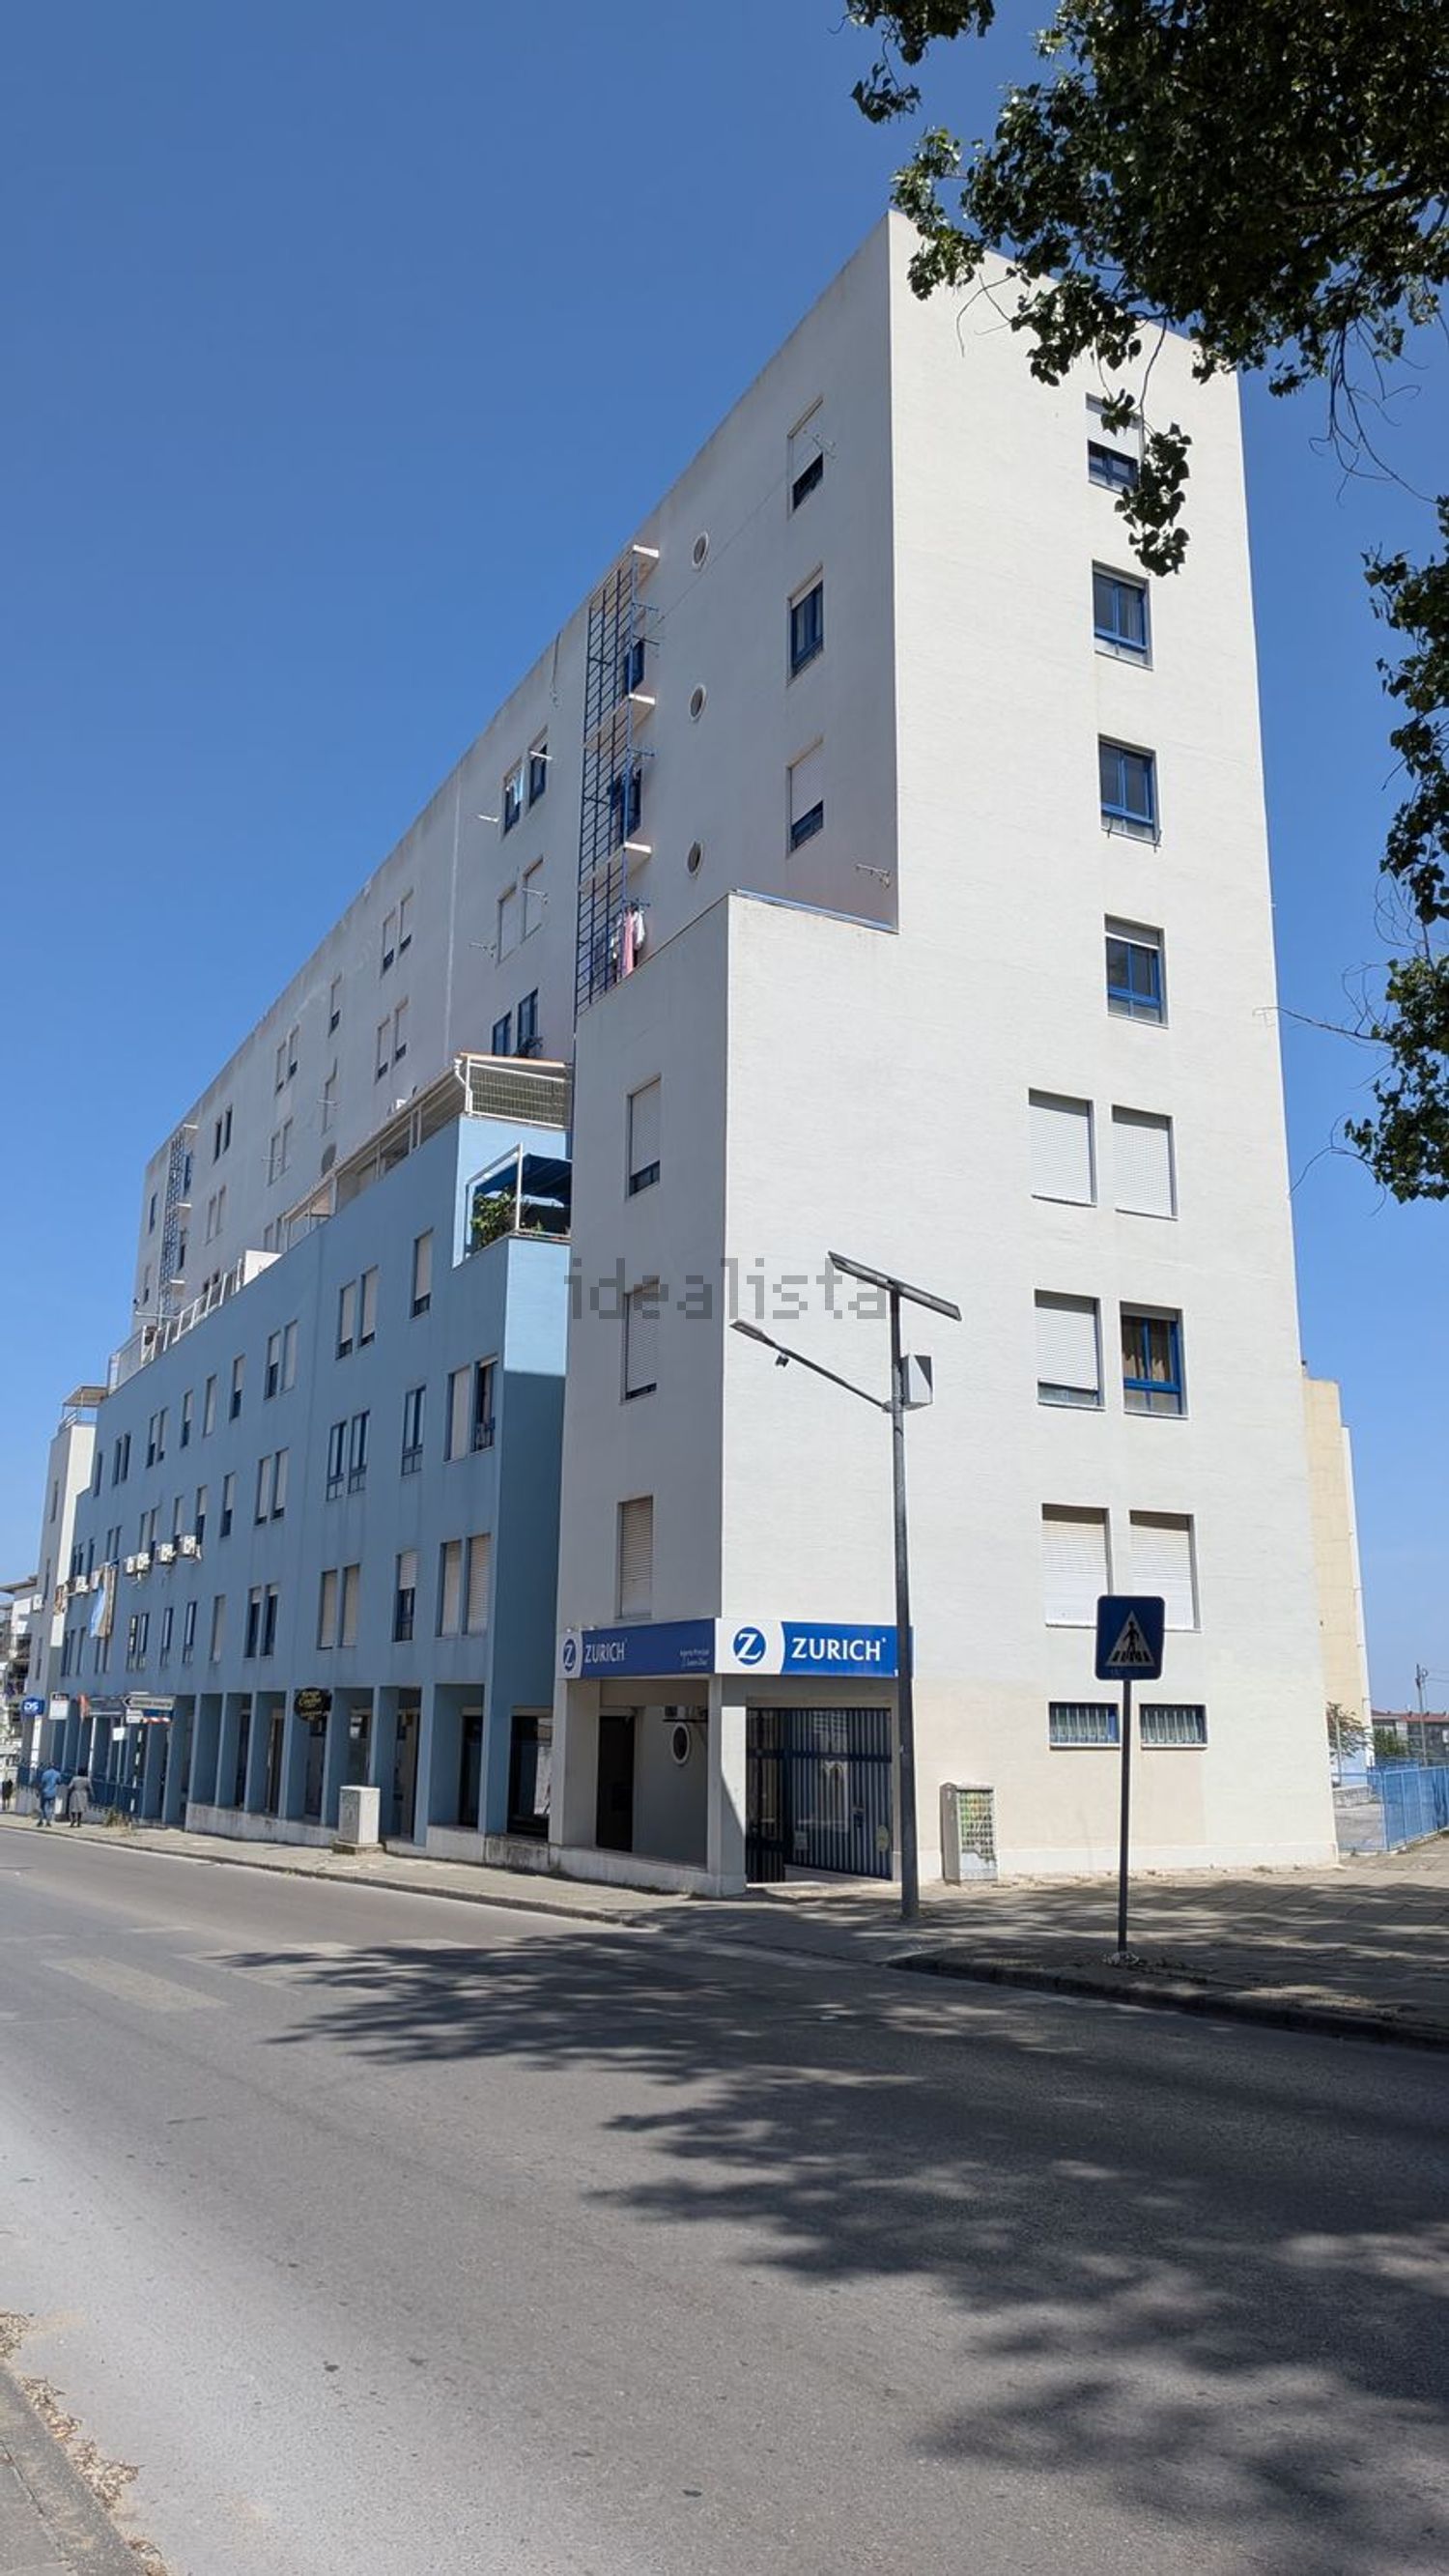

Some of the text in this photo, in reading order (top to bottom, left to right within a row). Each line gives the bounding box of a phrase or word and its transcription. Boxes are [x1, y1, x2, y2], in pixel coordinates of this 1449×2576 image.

[584, 1642, 625, 1664] ZURICH
[736, 1632, 761, 1660] Z
[791, 1637, 881, 1662] ZURICH
